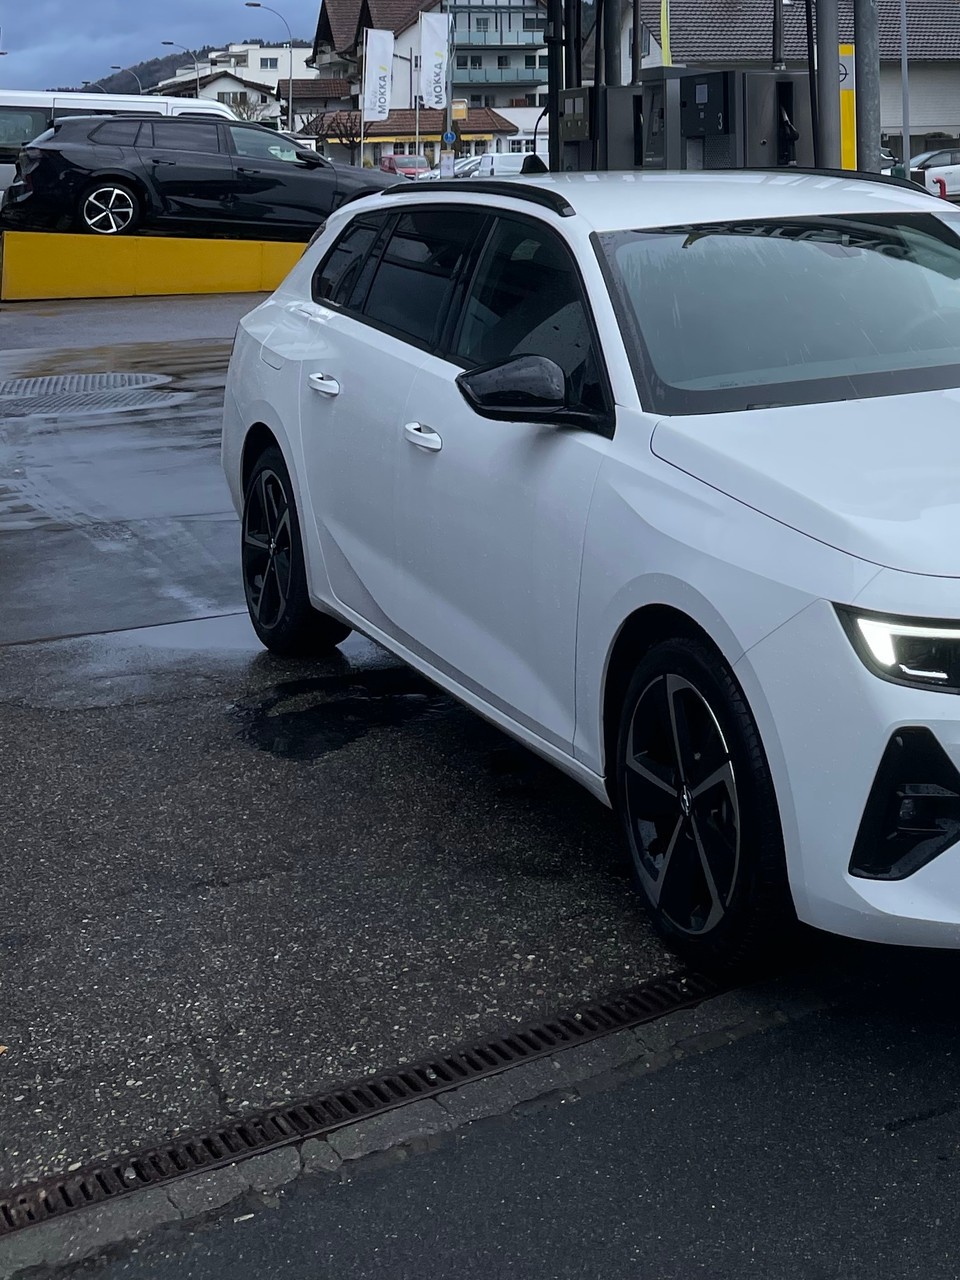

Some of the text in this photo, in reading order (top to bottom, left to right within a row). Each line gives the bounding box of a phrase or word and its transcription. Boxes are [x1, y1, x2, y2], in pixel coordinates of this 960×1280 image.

[378, 75, 387, 114] MOKKA
[433, 62, 443, 105] MOKKA
[717, 112, 723, 130] 3
